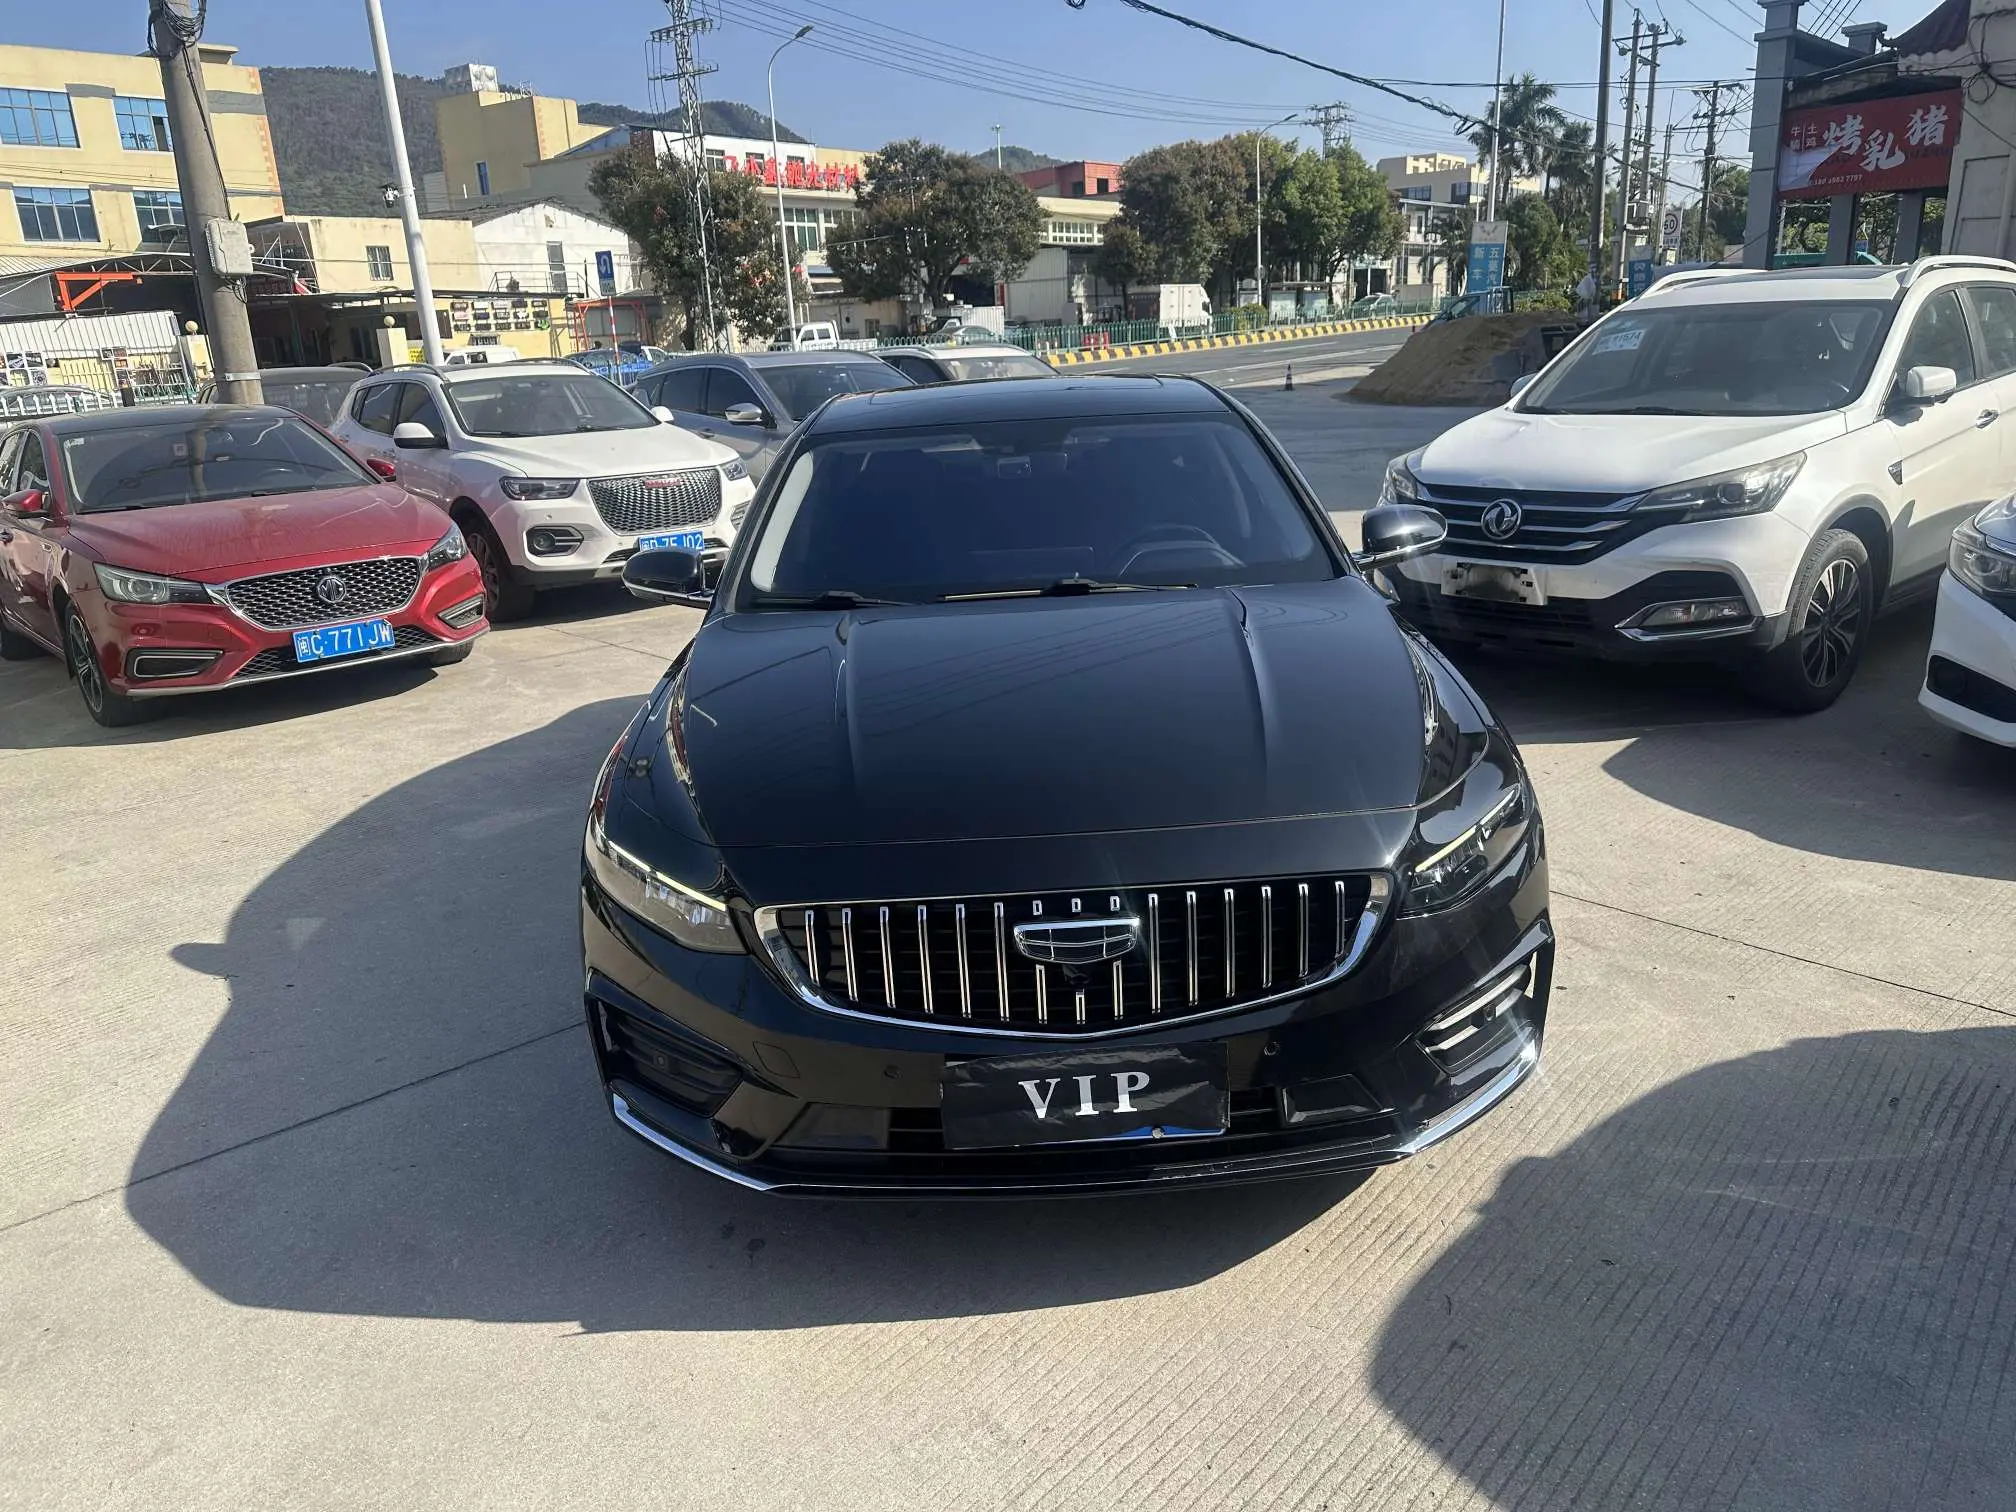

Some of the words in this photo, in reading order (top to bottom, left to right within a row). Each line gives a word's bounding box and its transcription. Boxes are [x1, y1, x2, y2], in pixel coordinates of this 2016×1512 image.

[1823, 105, 1949, 172] 烤乳猪
[320, 579, 343, 601] MG
[1017, 1071, 1150, 1119] VIP
